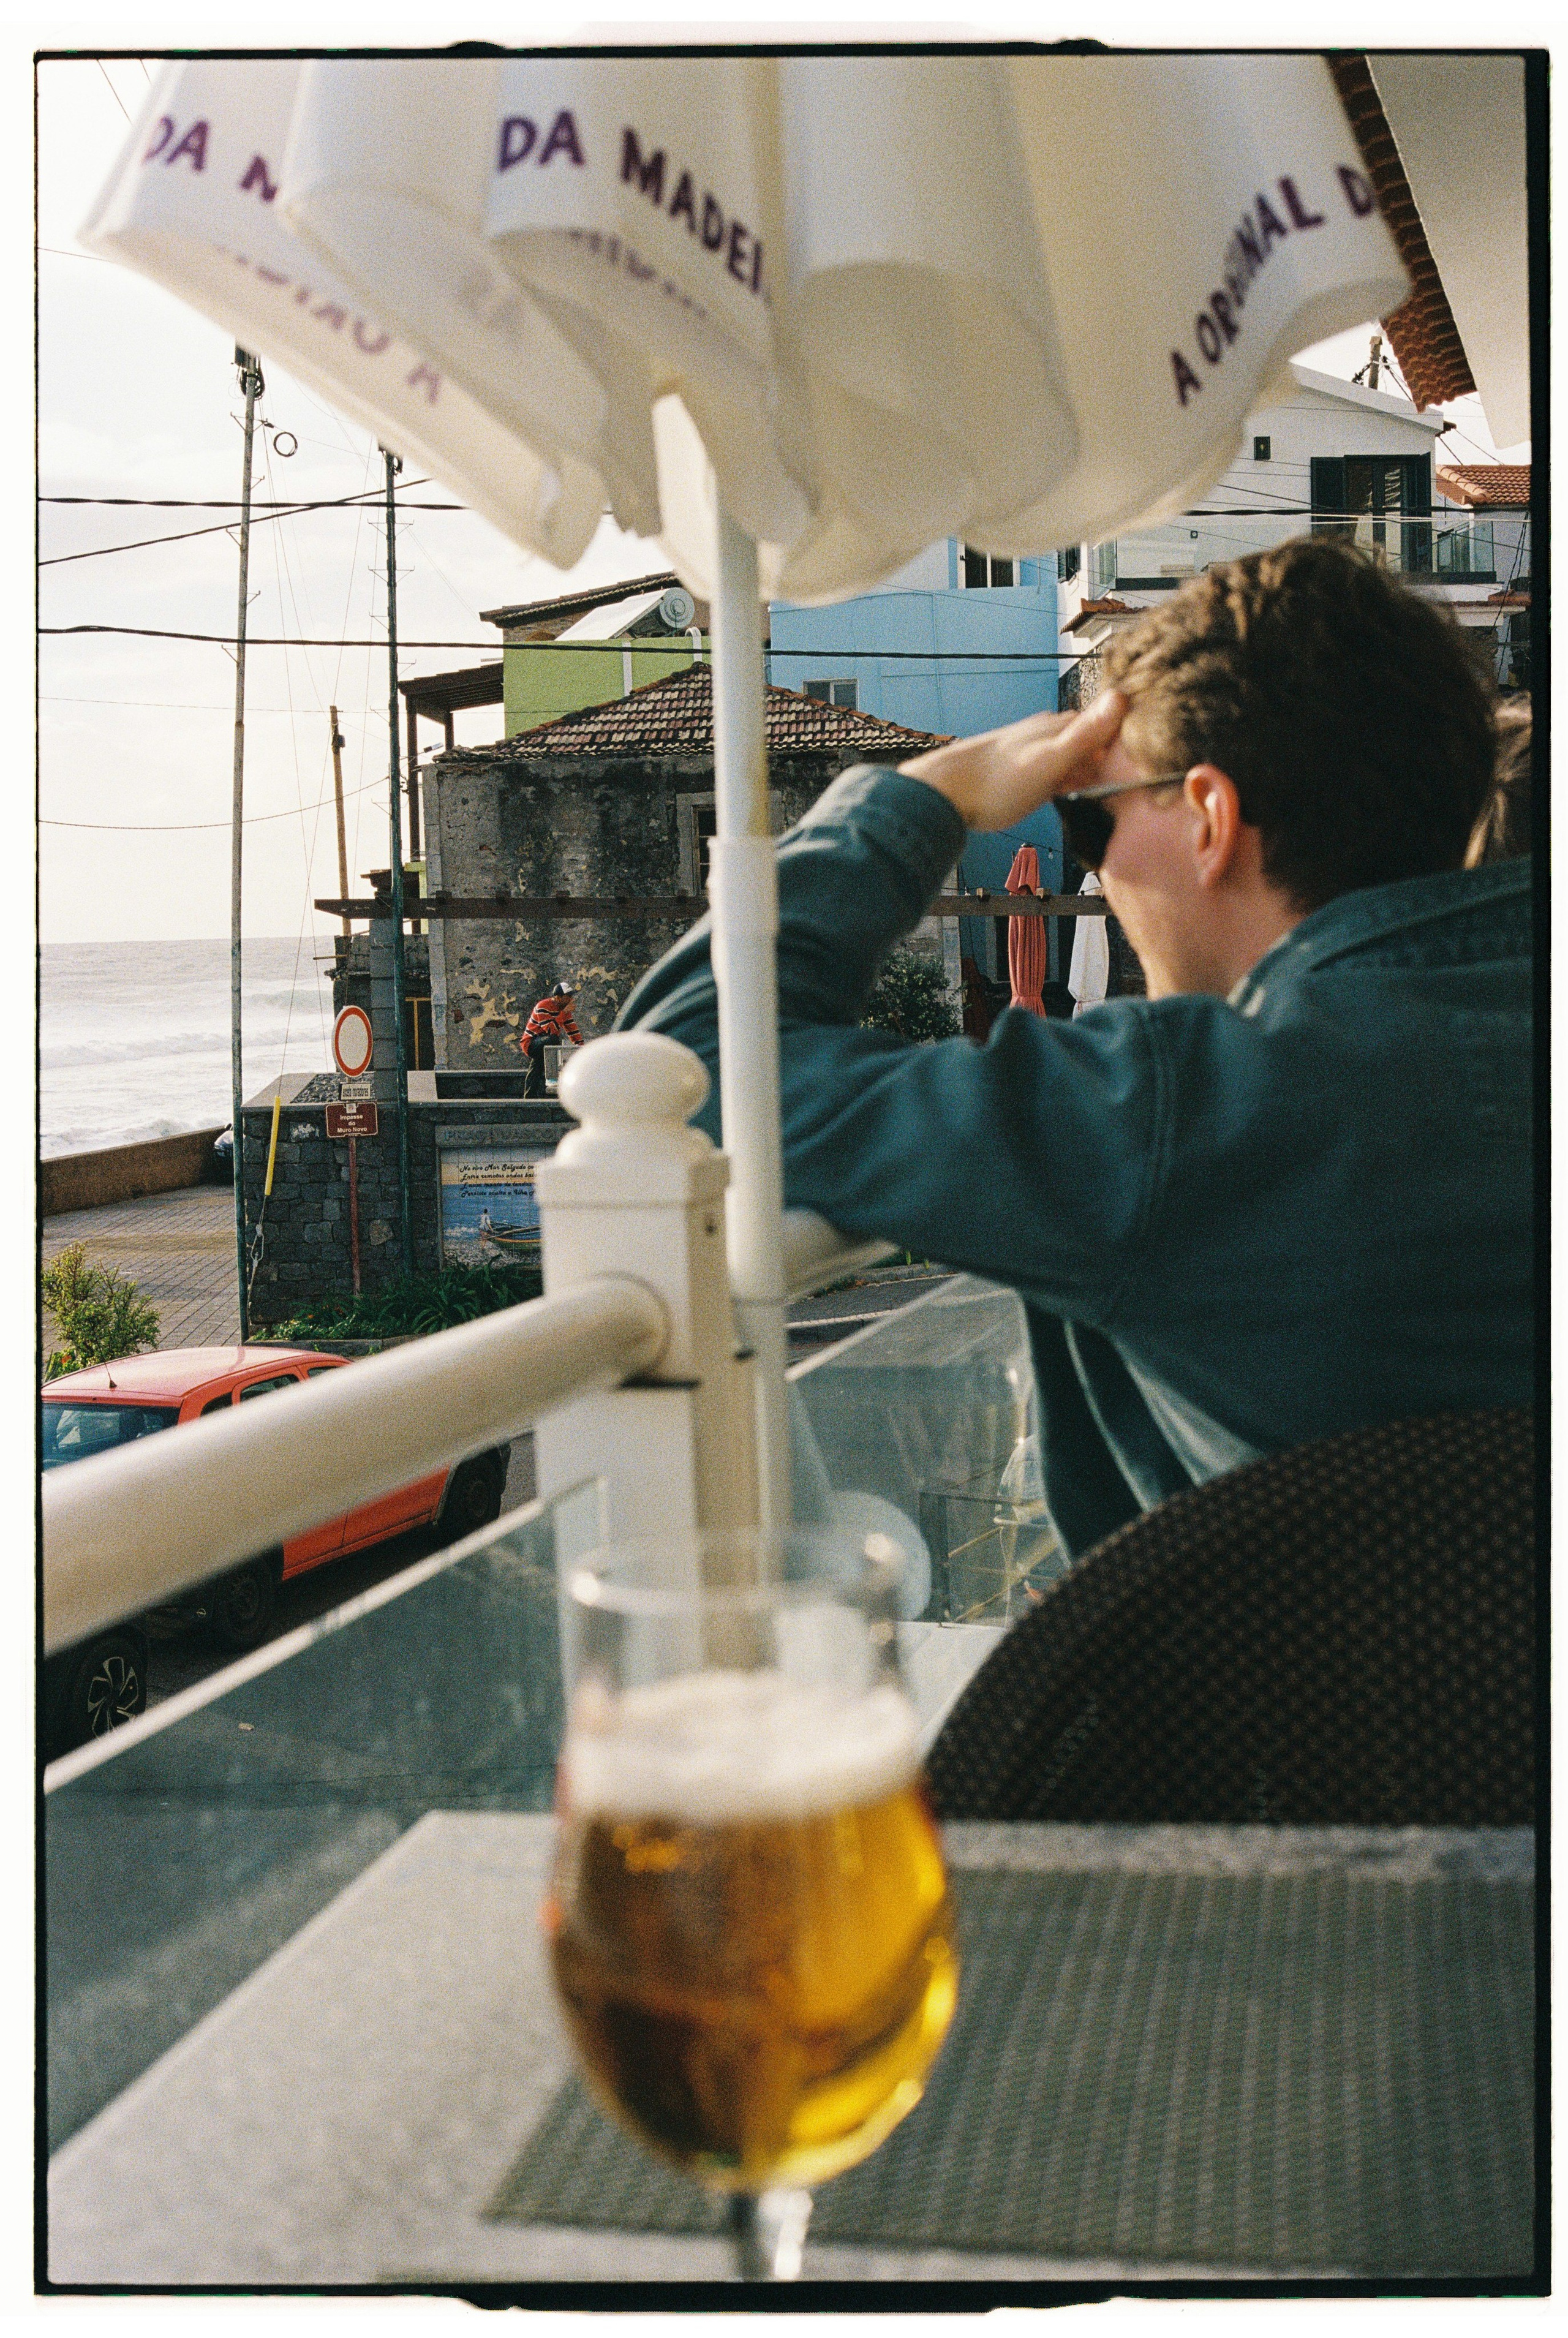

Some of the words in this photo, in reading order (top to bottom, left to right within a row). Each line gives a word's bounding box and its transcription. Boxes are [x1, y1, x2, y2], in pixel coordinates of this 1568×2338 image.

[497, 108, 585, 173] DA
[1170, 350, 1202, 407] A
[460, 1174, 479, 1182] Entre
[502, 1164, 526, 1172] Salgado
